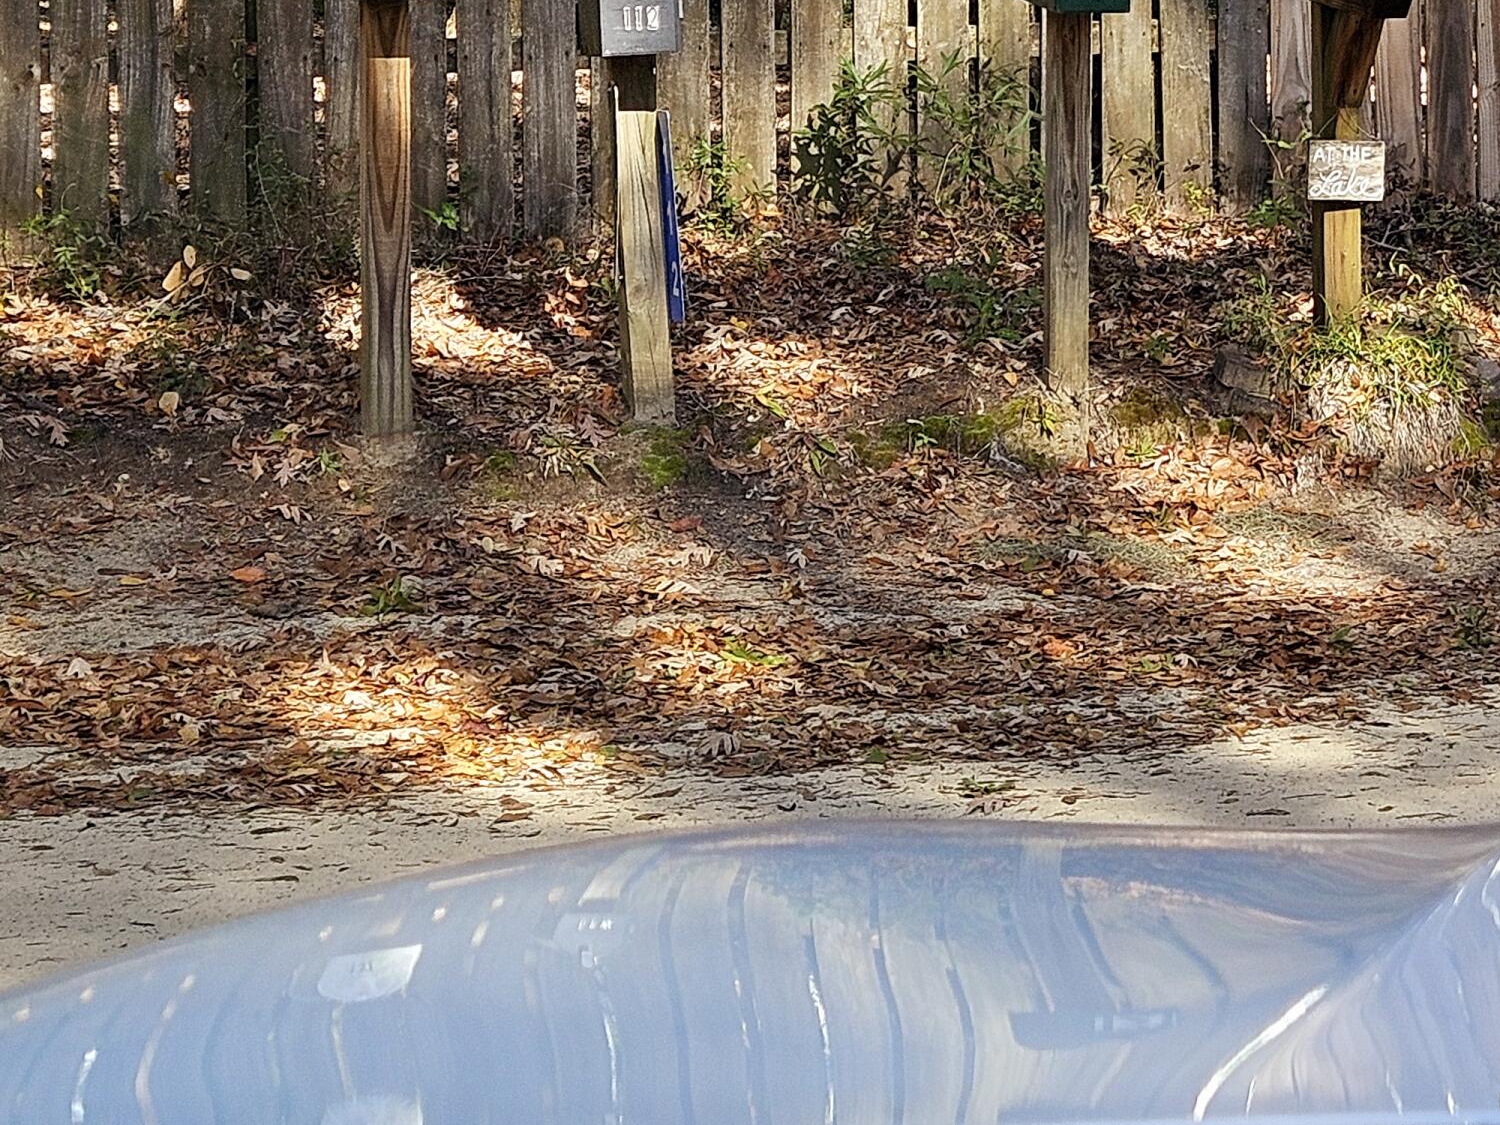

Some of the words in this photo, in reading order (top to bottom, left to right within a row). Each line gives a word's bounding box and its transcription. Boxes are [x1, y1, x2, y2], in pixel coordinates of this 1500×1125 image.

[622, 5, 660, 31] 112
[1312, 146, 1337, 164] AT
[1342, 144, 1373, 164] THE
[1309, 167, 1384, 197] Lake
